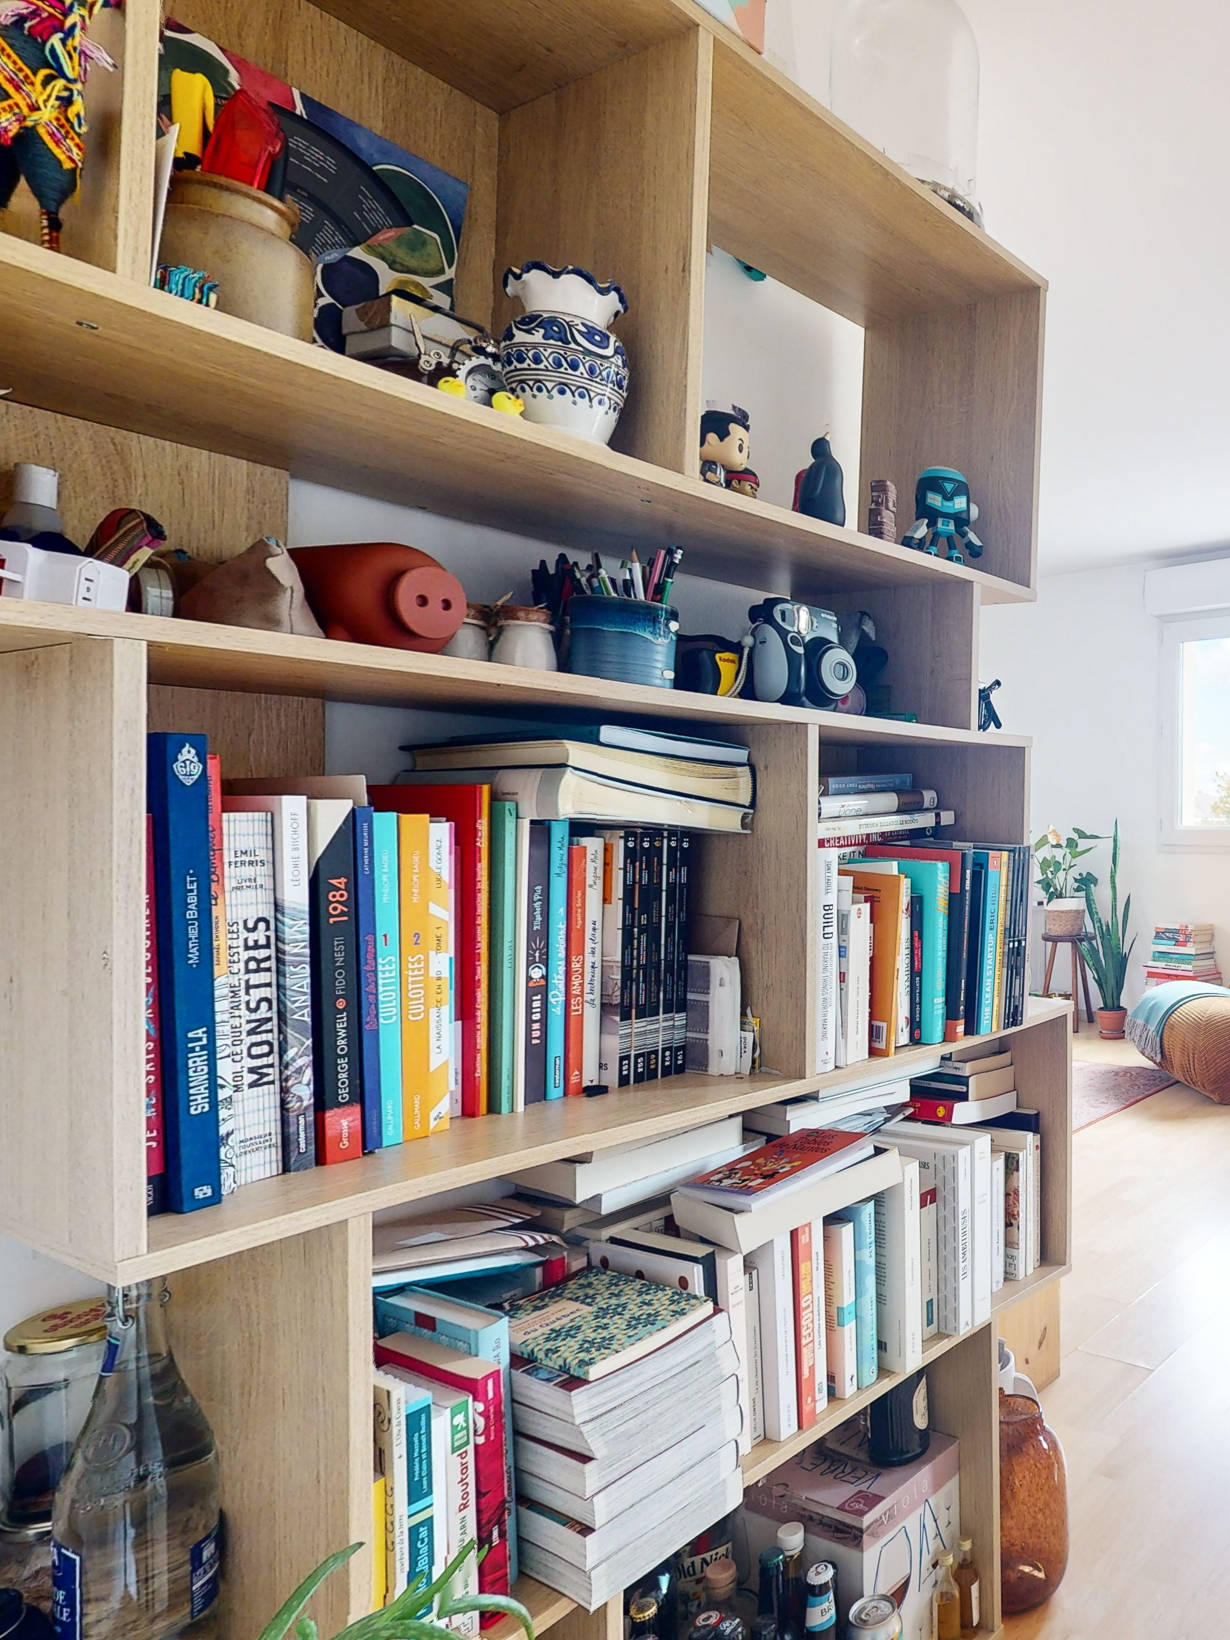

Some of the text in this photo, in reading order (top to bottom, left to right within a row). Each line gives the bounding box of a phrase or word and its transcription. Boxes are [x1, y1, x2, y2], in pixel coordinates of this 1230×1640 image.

[718, 655, 737, 665] Kodak
[228, 859, 266, 868] FERRIS
[233, 850, 260, 858] EMIL
[186, 875, 200, 964] MATHIEU BABLET
[328, 877, 349, 924] 1984
[822, 903, 835, 940] BUILD
[383, 934, 389, 946] 1
[413, 932, 421, 946] 2
[986, 933, 994, 976] STARTUP
[334, 936, 346, 995] FIDO NESTI
[406, 954, 425, 1021] CULOTTÉES
[570, 955, 583, 1015] LES AMOURS
[228, 921, 244, 1093] MOI, CE QUE J'AIME, C'EST LES
[243, 916, 275, 1089] MONSTRES
[287, 965, 310, 1021] ANAÏS
[983, 1007, 991, 1025] THE
[531, 994, 542, 1045] FUN GIRL
[187, 1026, 210, 1115] SHANGRI-LA
[336, 1012, 350, 1102] GEORGE ORWELL
[553, 1056, 561, 1088] casterman
[298, 1115, 307, 1152] casterman
[339, 1119, 350, 1149] Grasset
[802, 1294, 813, 1343] ECOLO
[457, 1449, 471, 1513] Routard
